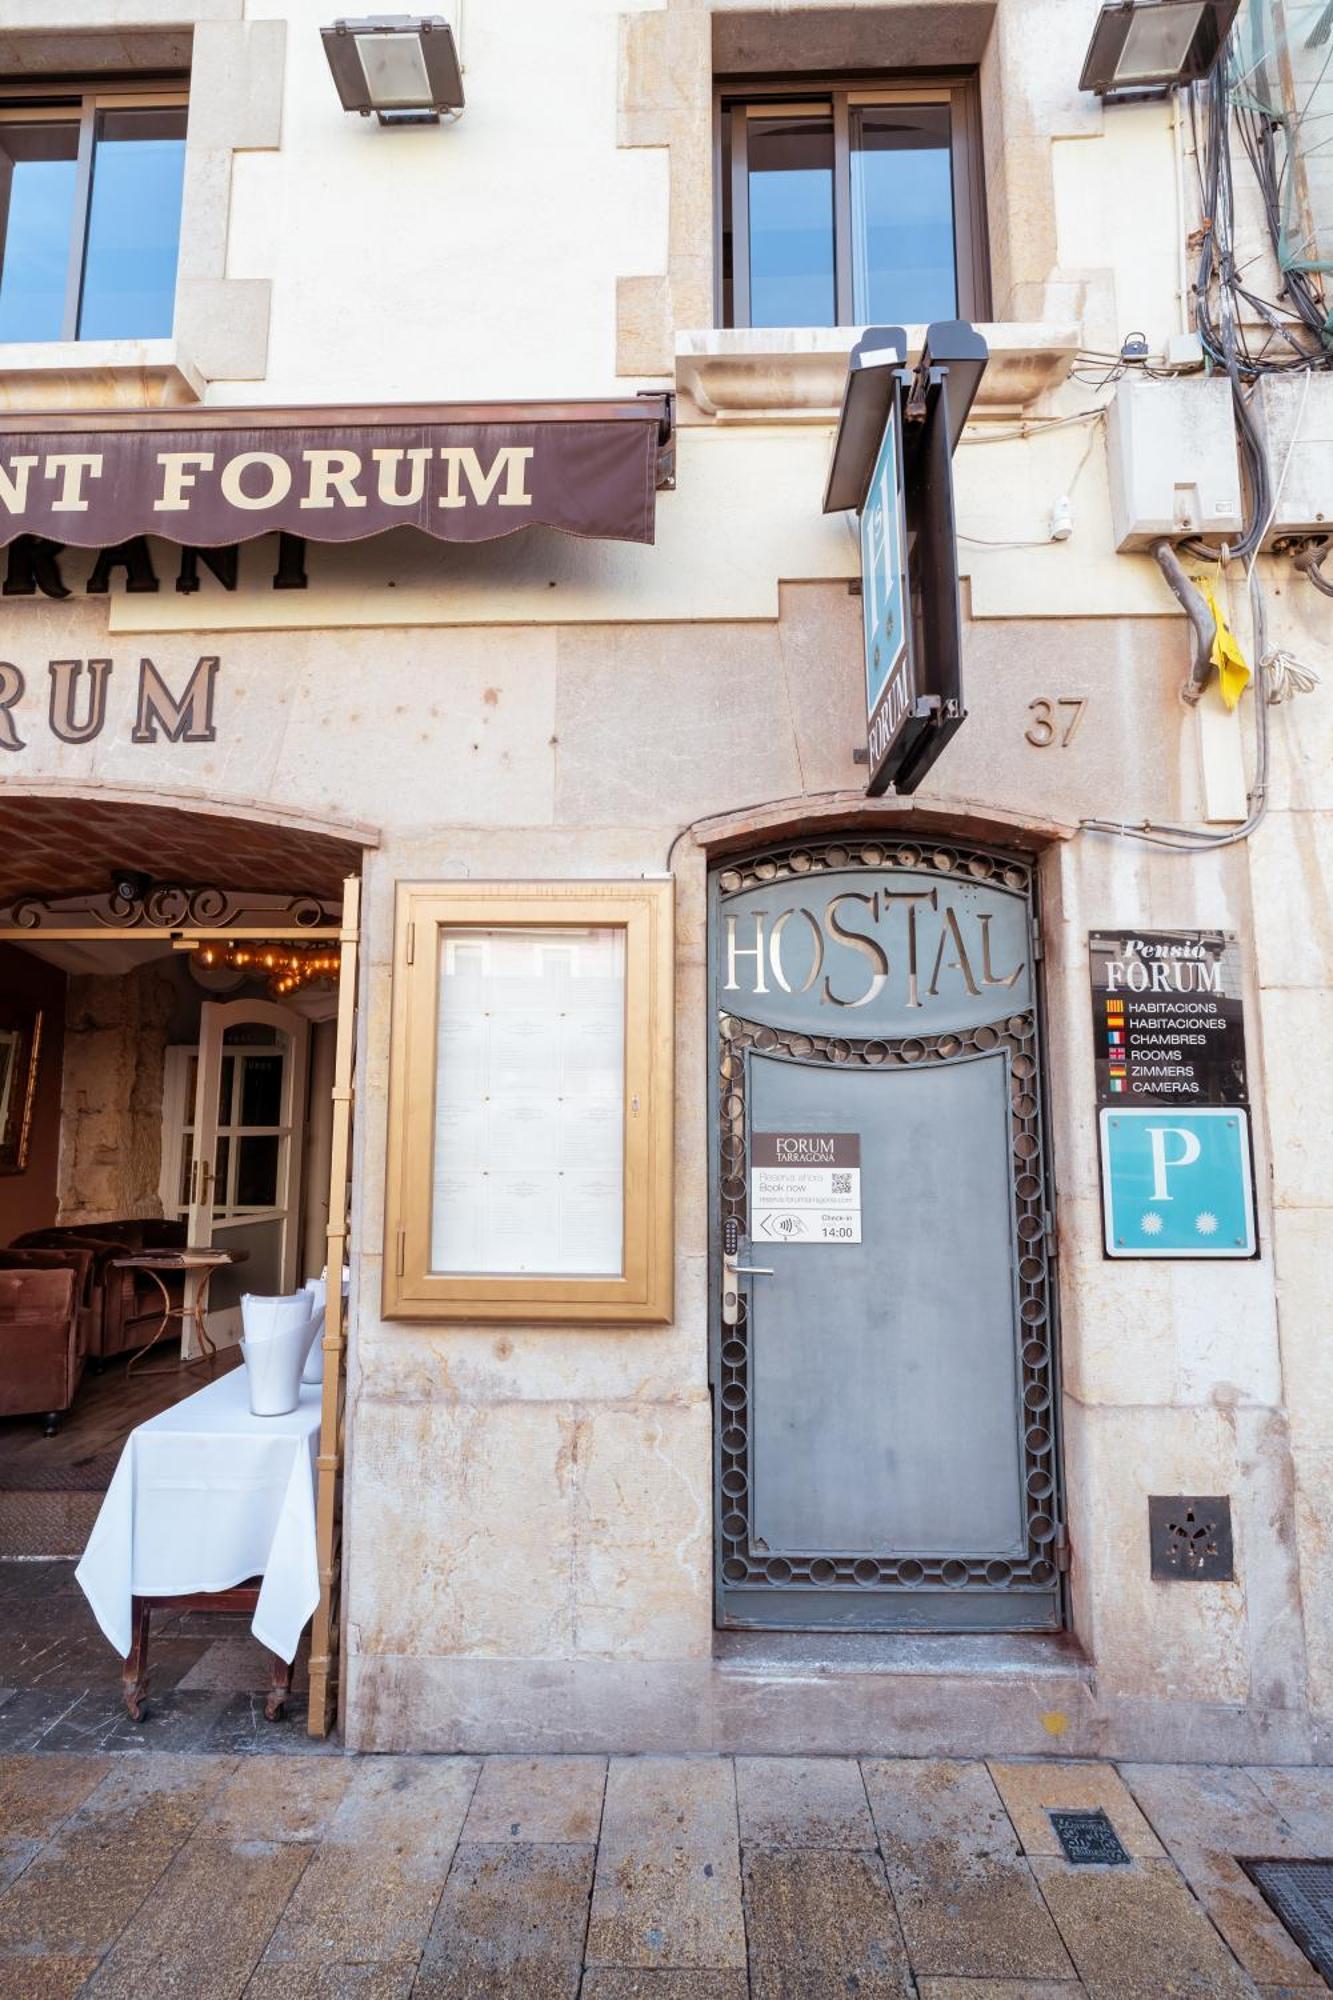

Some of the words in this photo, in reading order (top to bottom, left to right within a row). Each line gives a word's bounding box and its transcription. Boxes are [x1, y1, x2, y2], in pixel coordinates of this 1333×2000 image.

[153, 447, 534, 511] FORUM
[869, 656, 909, 775] FORUM
[1024, 696, 1089, 748] 37
[723, 887, 1026, 1008] HOSTAL
[1123, 940, 1206, 958] Pensió
[1104, 961, 1225, 993] FORUM
[1128, 1003, 1217, 1014] HABITACIONS
[1129, 1018, 1227, 1029] HABITACIONES
[1130, 1034, 1206, 1045] CHAMBRES
[1131, 1050, 1182, 1061] ROOMS
[1131, 1066, 1194, 1077] ZIMMERS
[1132, 1082, 1200, 1093] CAMERAS
[776, 1138, 834, 1153] FORUM
[776, 1153, 835, 1162] TARRAGONA
[1144, 1128, 1201, 1200] P
[821, 1227, 853, 1238] 14:00
